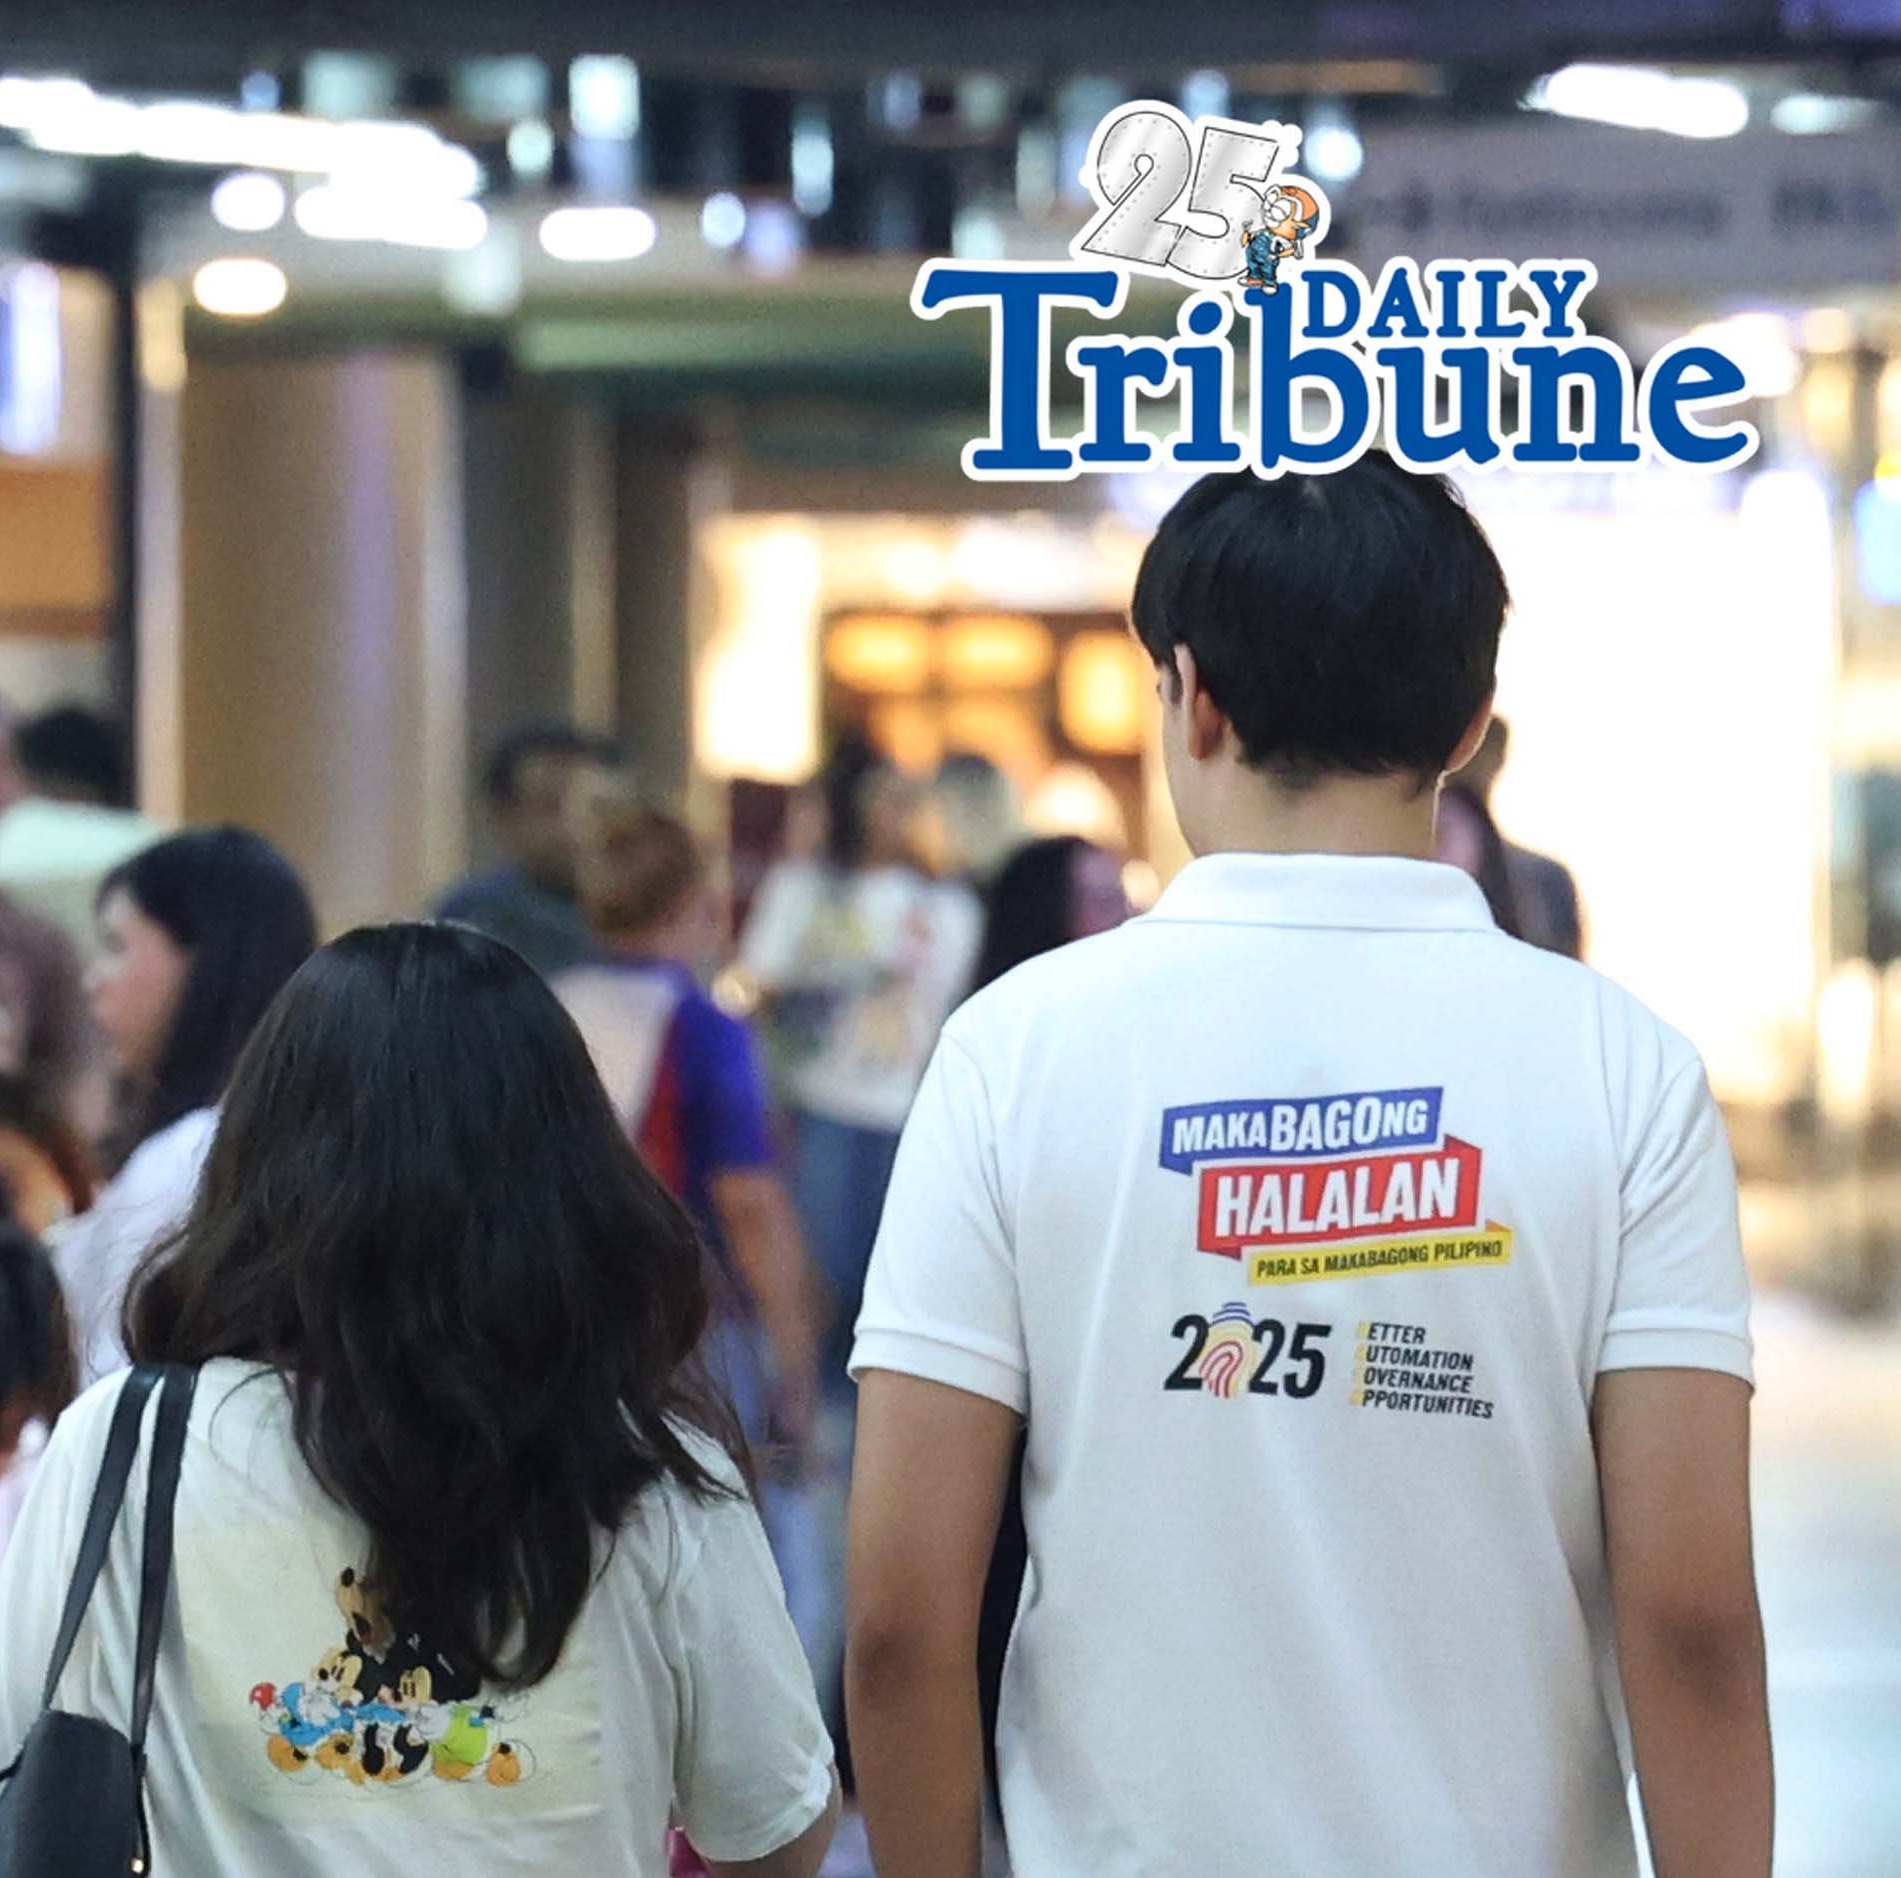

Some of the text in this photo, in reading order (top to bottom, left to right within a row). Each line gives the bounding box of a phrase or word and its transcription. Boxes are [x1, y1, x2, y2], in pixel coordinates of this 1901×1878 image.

[1215, 1158, 1460, 1237] HALALAN
[1256, 1240, 1503, 1278] PARA SA MAKABAGONG PILIPINO
